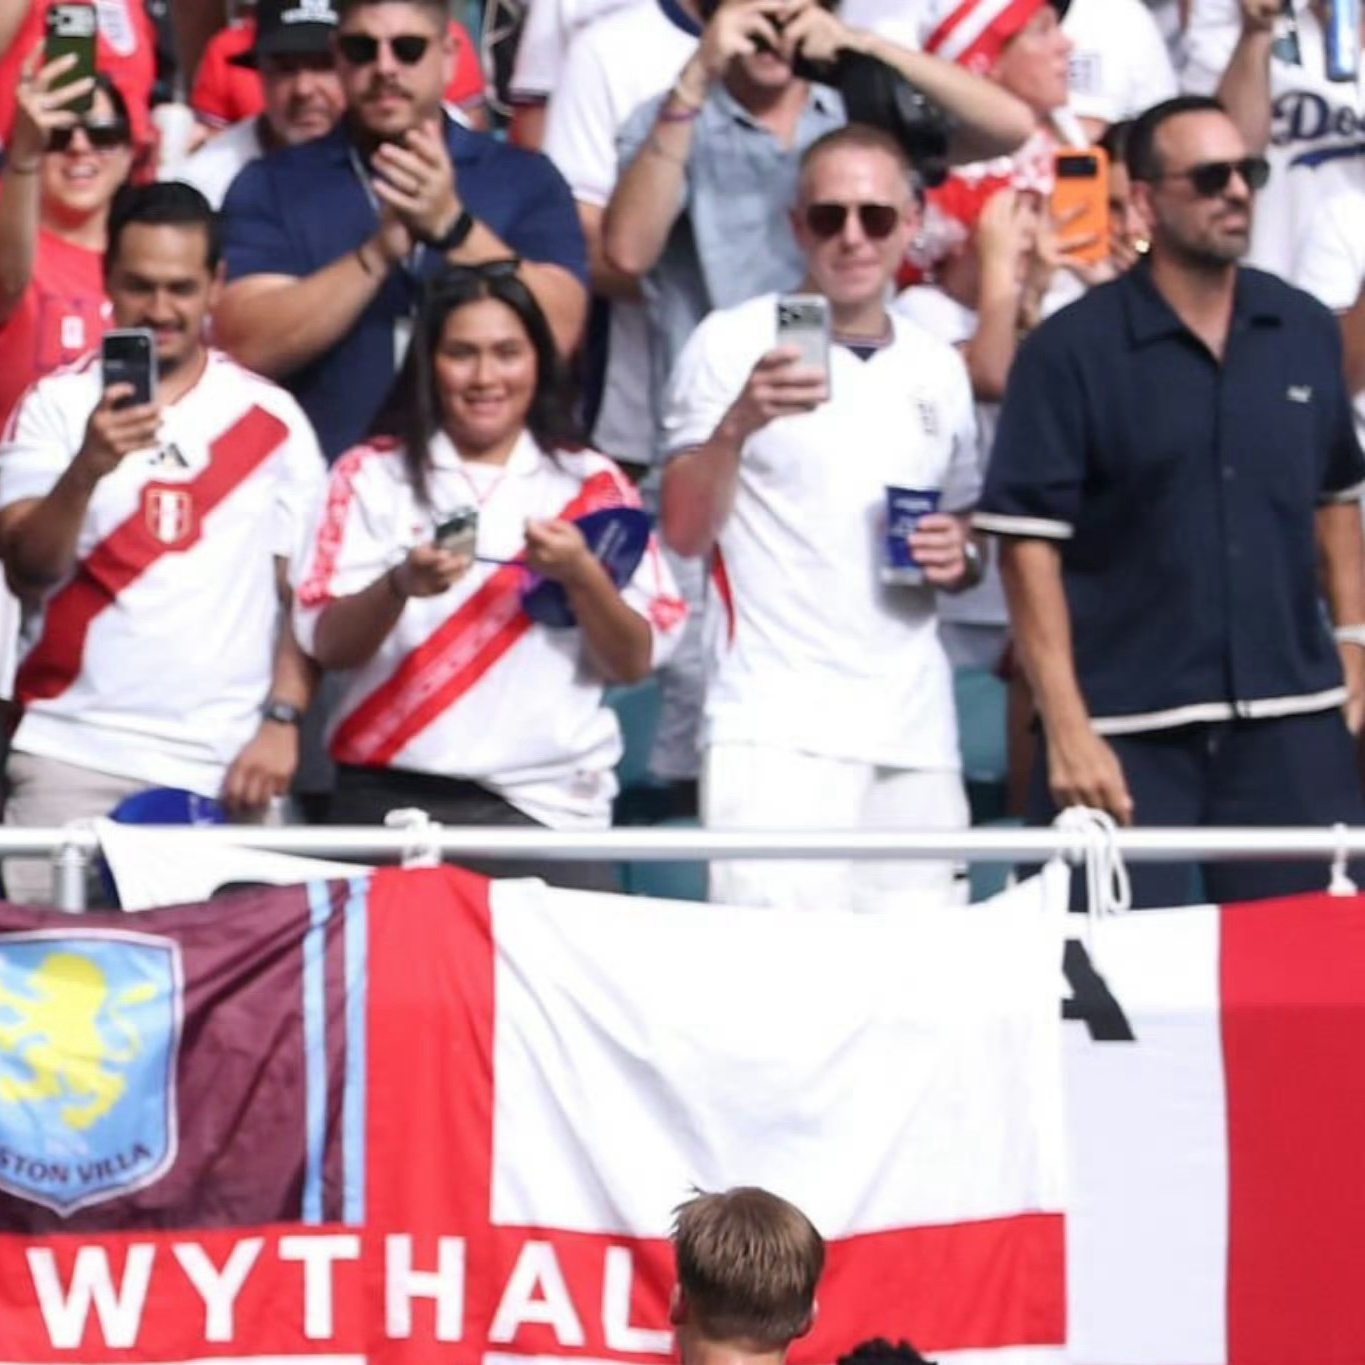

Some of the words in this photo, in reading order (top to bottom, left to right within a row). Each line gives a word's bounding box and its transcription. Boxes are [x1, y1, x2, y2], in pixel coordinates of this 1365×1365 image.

[1270, 89, 1365, 147] Do
[77, 1142, 153, 1184] VILLA
[26, 1233, 675, 1356] WYTHAL
